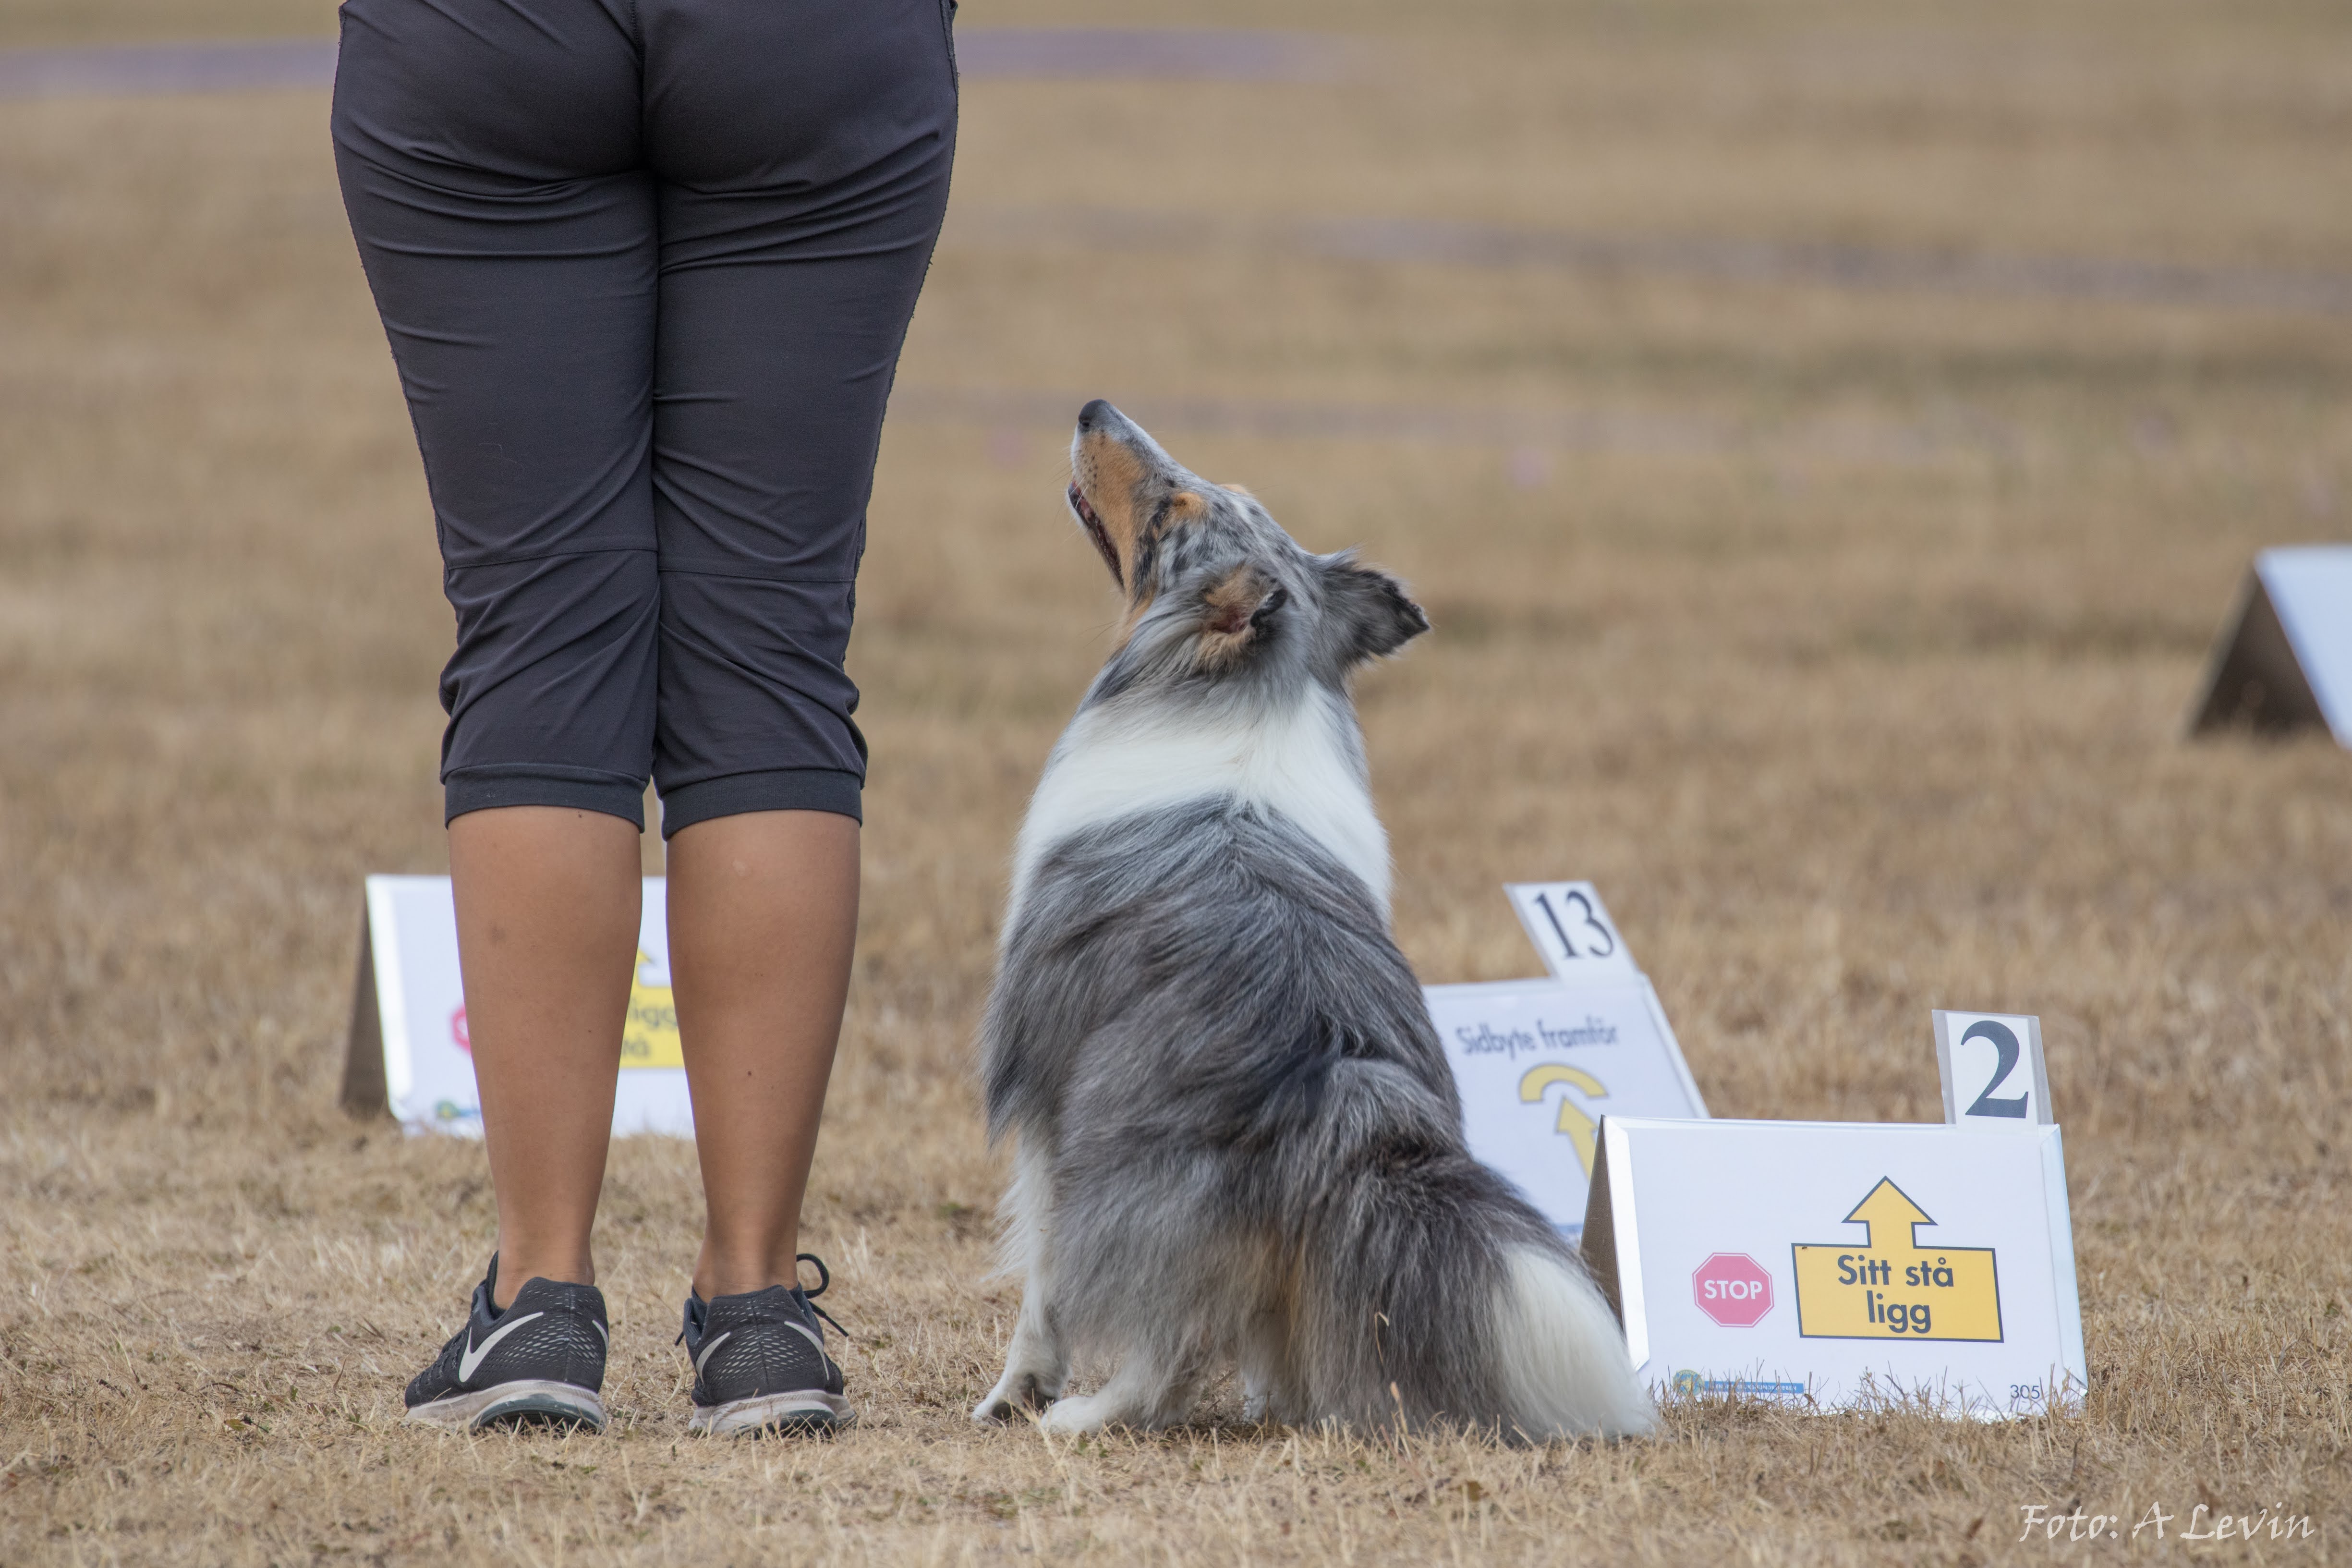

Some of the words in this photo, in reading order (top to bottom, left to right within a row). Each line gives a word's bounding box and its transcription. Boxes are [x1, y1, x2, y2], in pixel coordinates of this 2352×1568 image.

[1532, 890, 1614, 958] 13
[1455, 1022, 1536, 1061] Sidbyte
[1960, 1020, 2029, 1119] 2
[1704, 1279, 1763, 1300] STOP
[1837, 1254, 1892, 1285] Sitt
[1905, 1257, 1954, 1287] stå
[1867, 1290, 1931, 1334] ligg
[2010, 1384, 2040, 1399] 305
